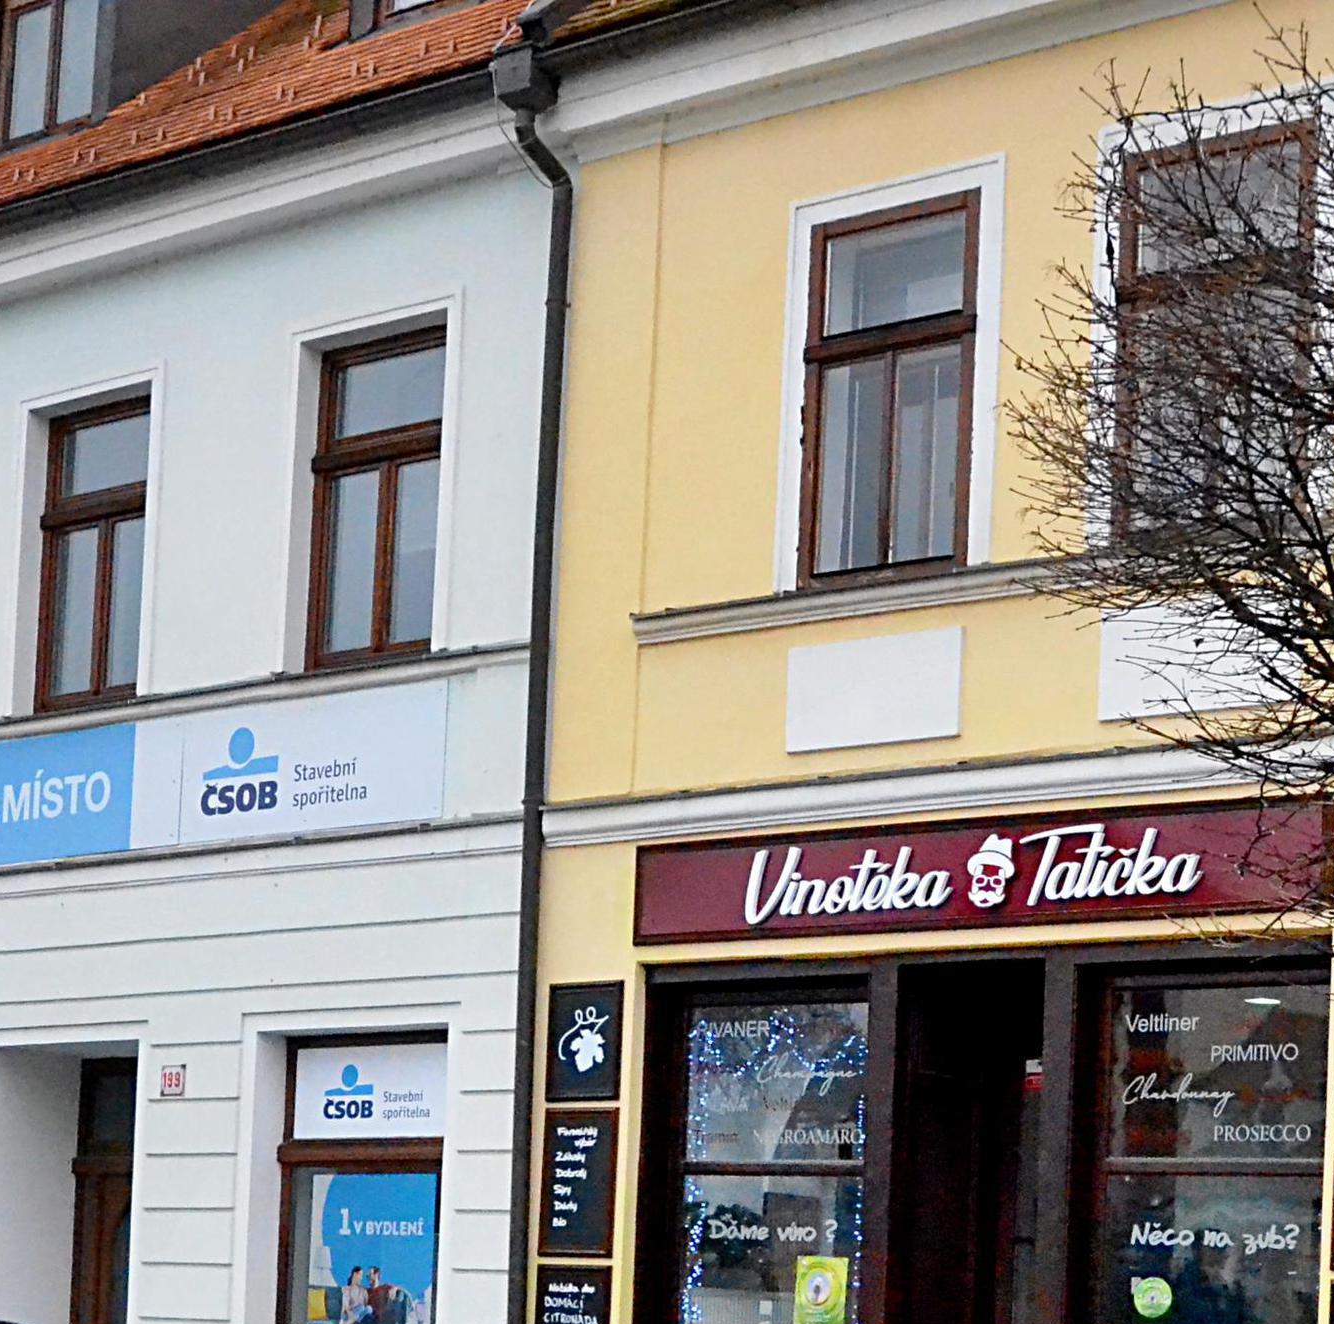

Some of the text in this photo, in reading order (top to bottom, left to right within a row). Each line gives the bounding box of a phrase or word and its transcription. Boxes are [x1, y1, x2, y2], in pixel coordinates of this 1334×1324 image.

[293, 757, 357, 783] Stavební
[1, 769, 112, 824] MÍSTO
[200, 780, 279, 817] ČSOB
[292, 783, 368, 811] spořitelna
[744, 846, 953, 926] Vinotéka
[1125, 1013, 1201, 1033] Veltliner
[1210, 1043, 1299, 1062] PRIMITIVO
[163, 1072, 181, 1088] 199
[756, 1052, 858, 1096] Champagne
[383, 1090, 424, 1103] Stavební
[1122, 1072, 1235, 1118] Chardonnay
[323, 1099, 374, 1120] ČSOB
[382, 1105, 431, 1121] spořitelna
[753, 1128, 863, 1146] NROAMARO
[1213, 1124, 1312, 1142] PROSECCO
[339, 1208, 351, 1236] 1
[366, 1214, 425, 1236] BYDLENÍ
[552, 1217, 567, 1227] Bio
[708, 1213, 769, 1242] Dáme
[777, 1221, 817, 1243] víno
[1130, 1222, 1300, 1254] Něco na zub?
[544, 1294, 584, 1309] DOMÁCÍ
